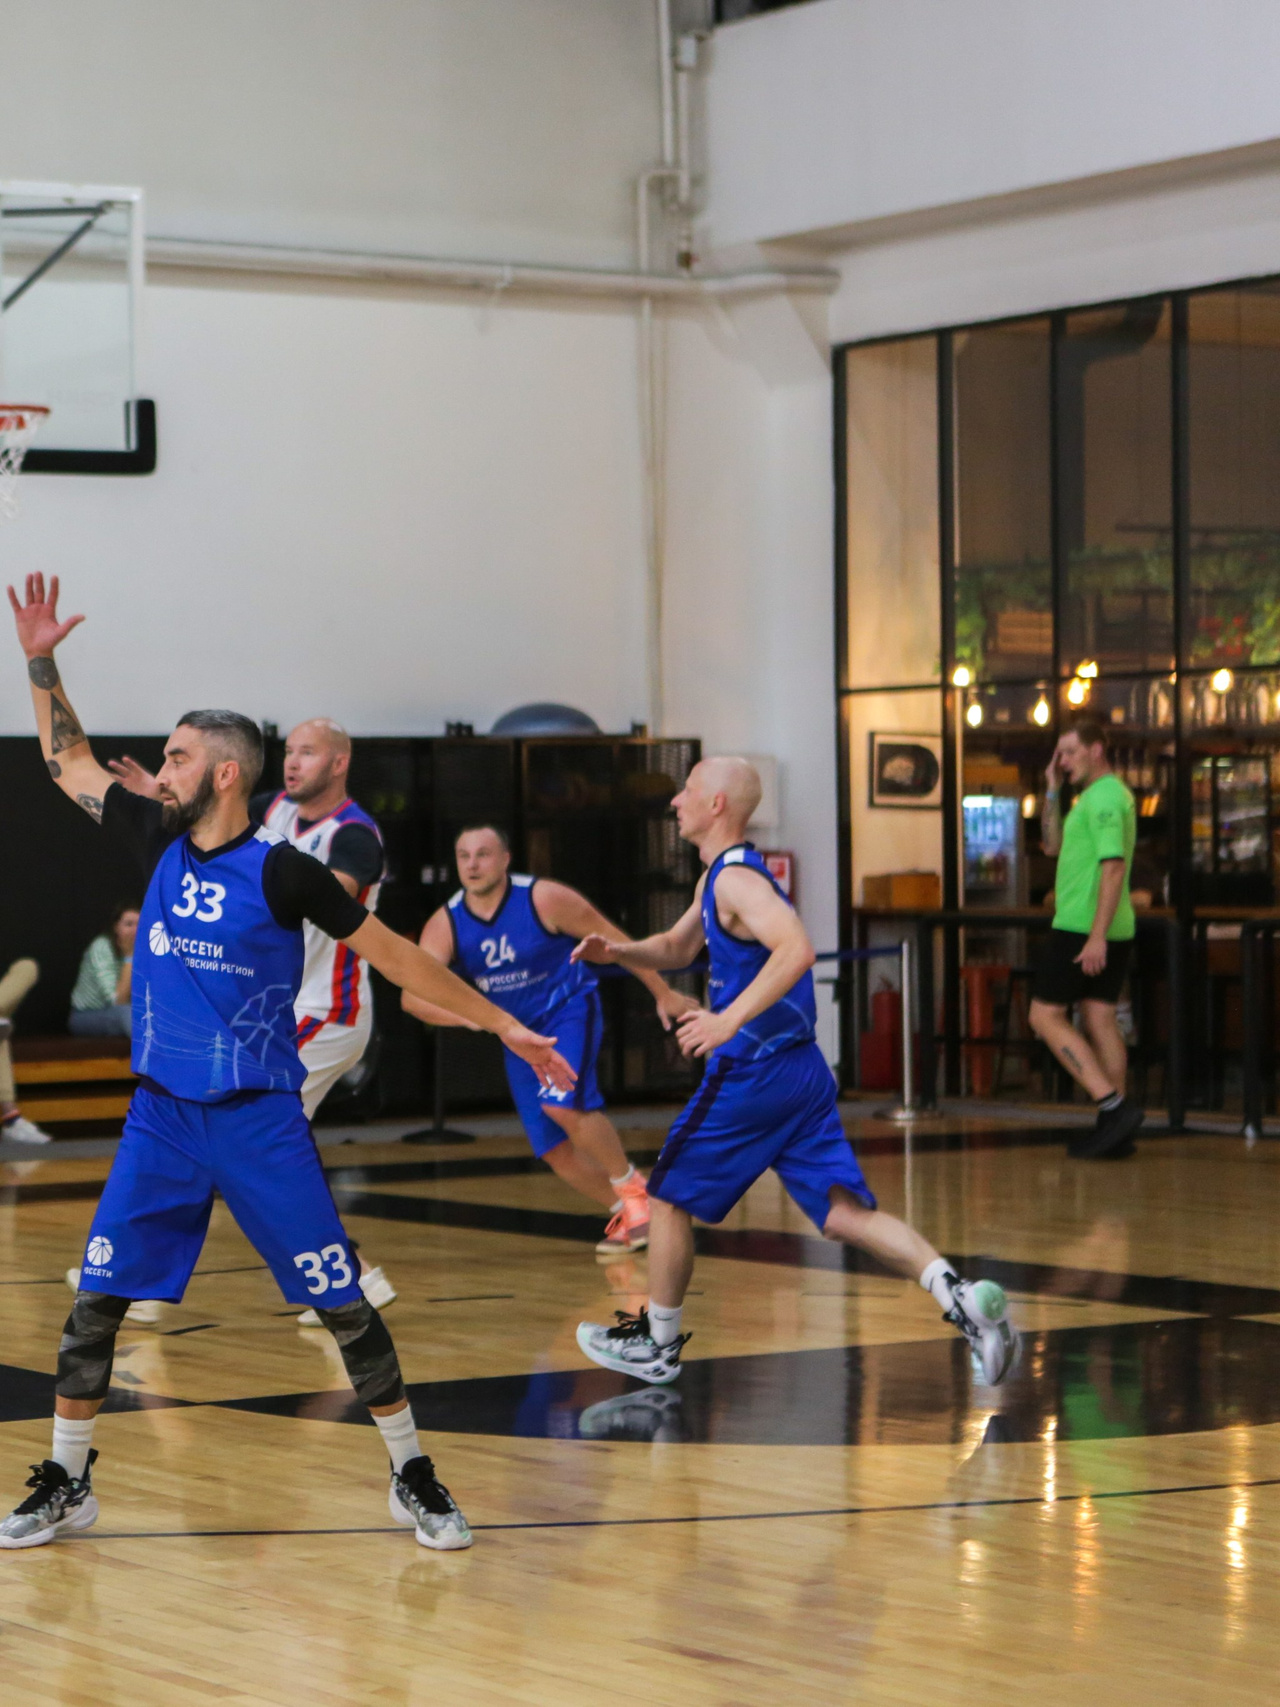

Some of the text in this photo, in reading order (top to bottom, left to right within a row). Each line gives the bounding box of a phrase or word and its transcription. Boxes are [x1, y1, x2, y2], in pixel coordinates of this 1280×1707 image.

[172, 872, 226, 922] 33
[170, 936, 224, 959] ОССЕТИ
[481, 934, 516, 969] 24
[220, 963, 254, 977] РЕГИОН
[293, 1243, 352, 1295] 33
